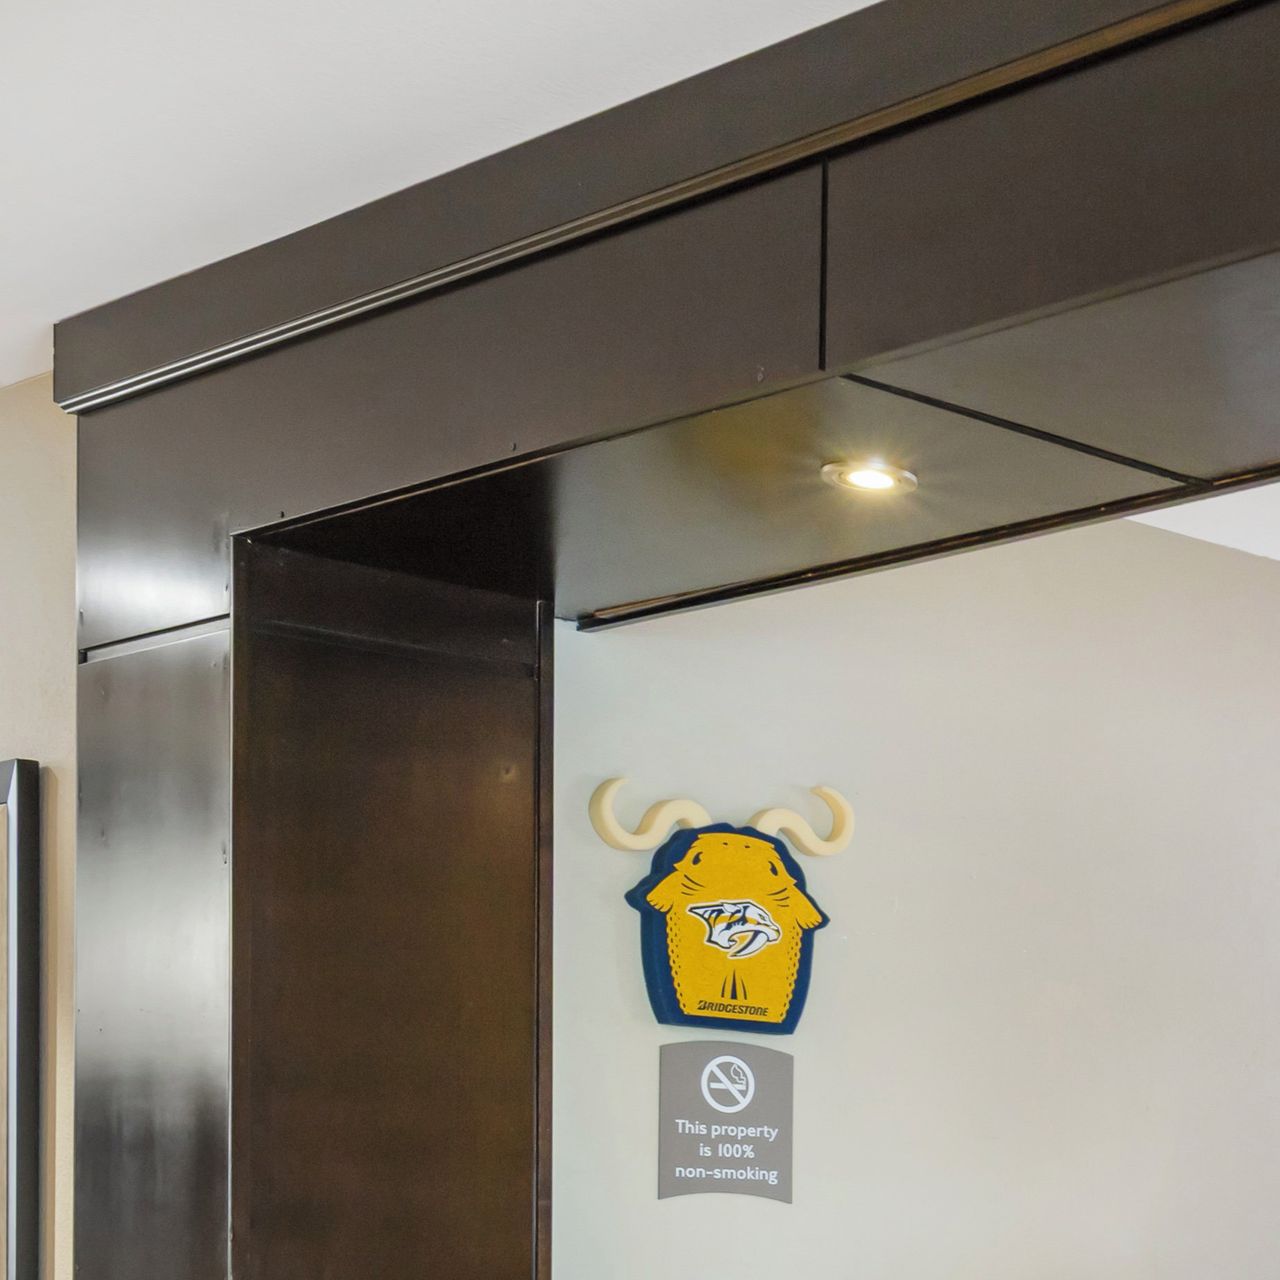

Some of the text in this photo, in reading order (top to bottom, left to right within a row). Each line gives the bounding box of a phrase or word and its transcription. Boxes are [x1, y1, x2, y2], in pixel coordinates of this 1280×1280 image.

[697, 1000, 770, 1017] BRIDGESTONE
[675, 1119, 779, 1142] This property
[699, 1143, 755, 1159] is 100%
[675, 1166, 778, 1185] non-smoking
